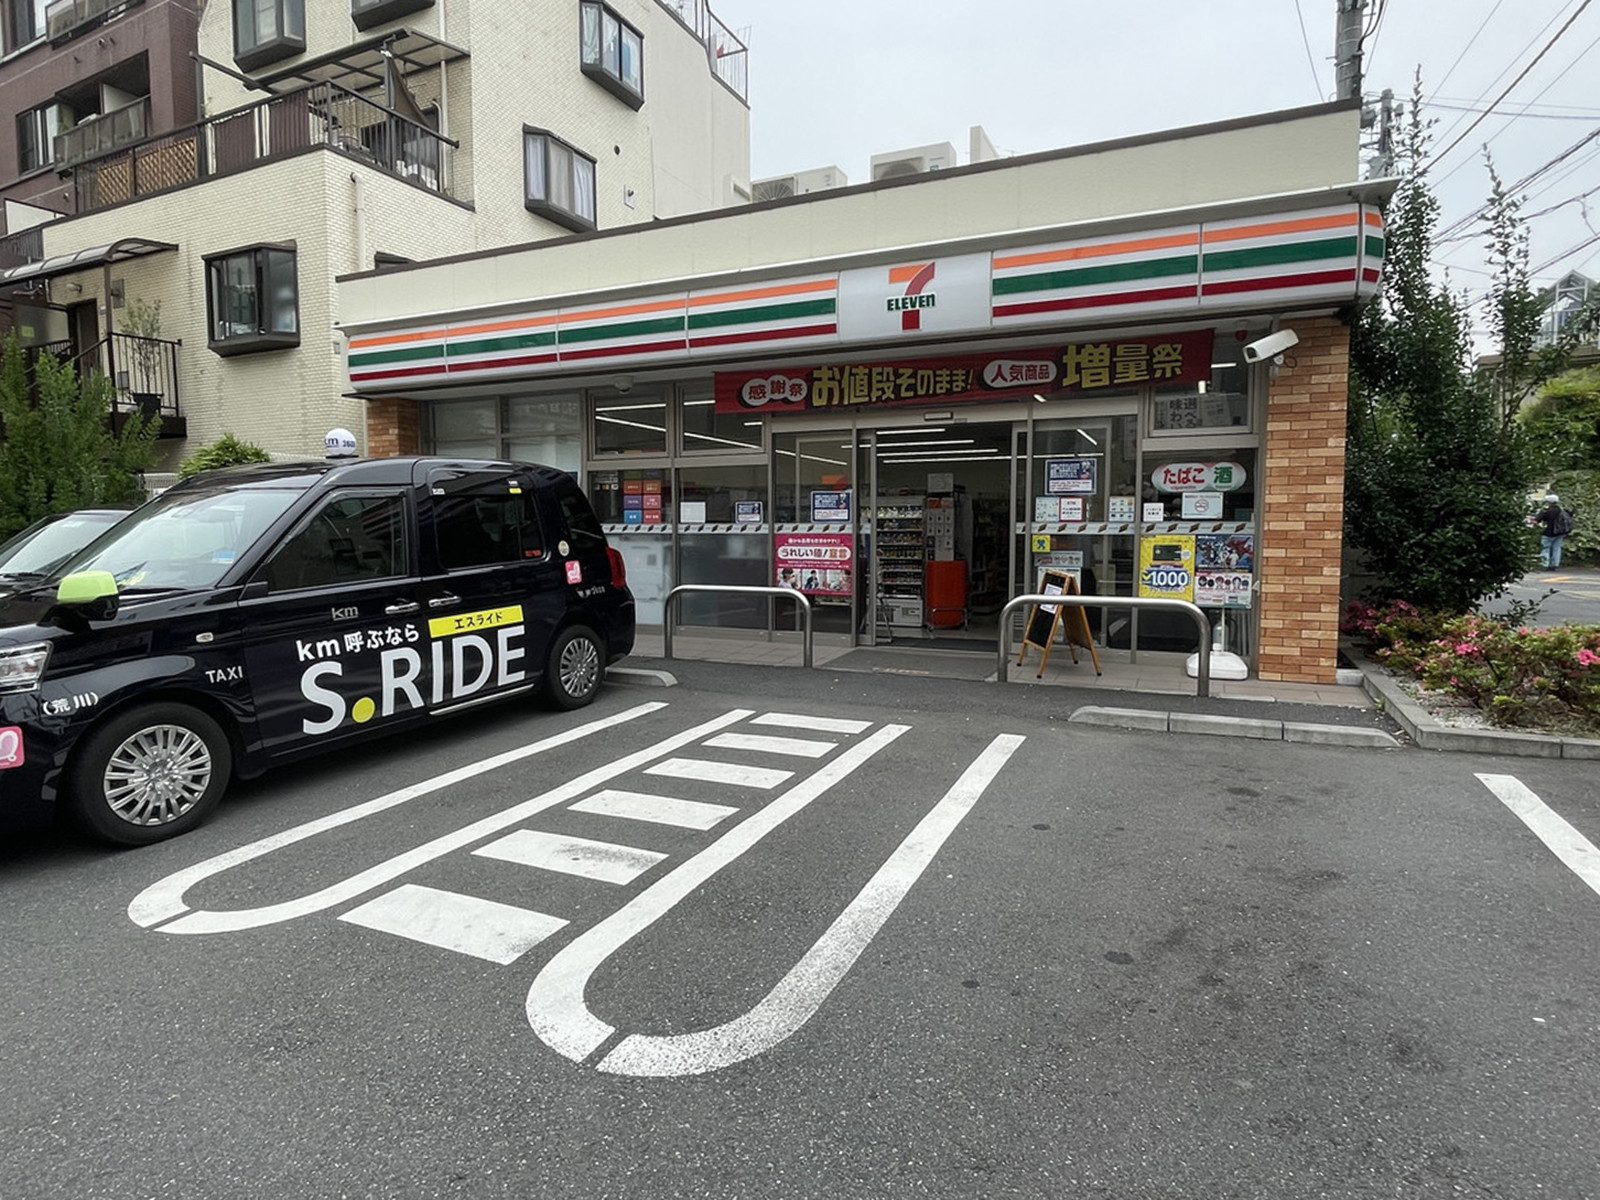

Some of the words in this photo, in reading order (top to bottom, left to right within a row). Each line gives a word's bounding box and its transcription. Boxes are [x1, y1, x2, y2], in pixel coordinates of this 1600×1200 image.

[990, 364, 1049, 382] 人気商品
[1062, 344, 1183, 388] 増量祭
[748, 380, 804, 400] 感謝祭
[1163, 467, 1205, 484] たばこ
[1214, 466, 1233, 484] 酒
[331, 606, 358, 621] km
[454, 612, 504, 630] エスライド
[205, 665, 244, 683] TAXI
